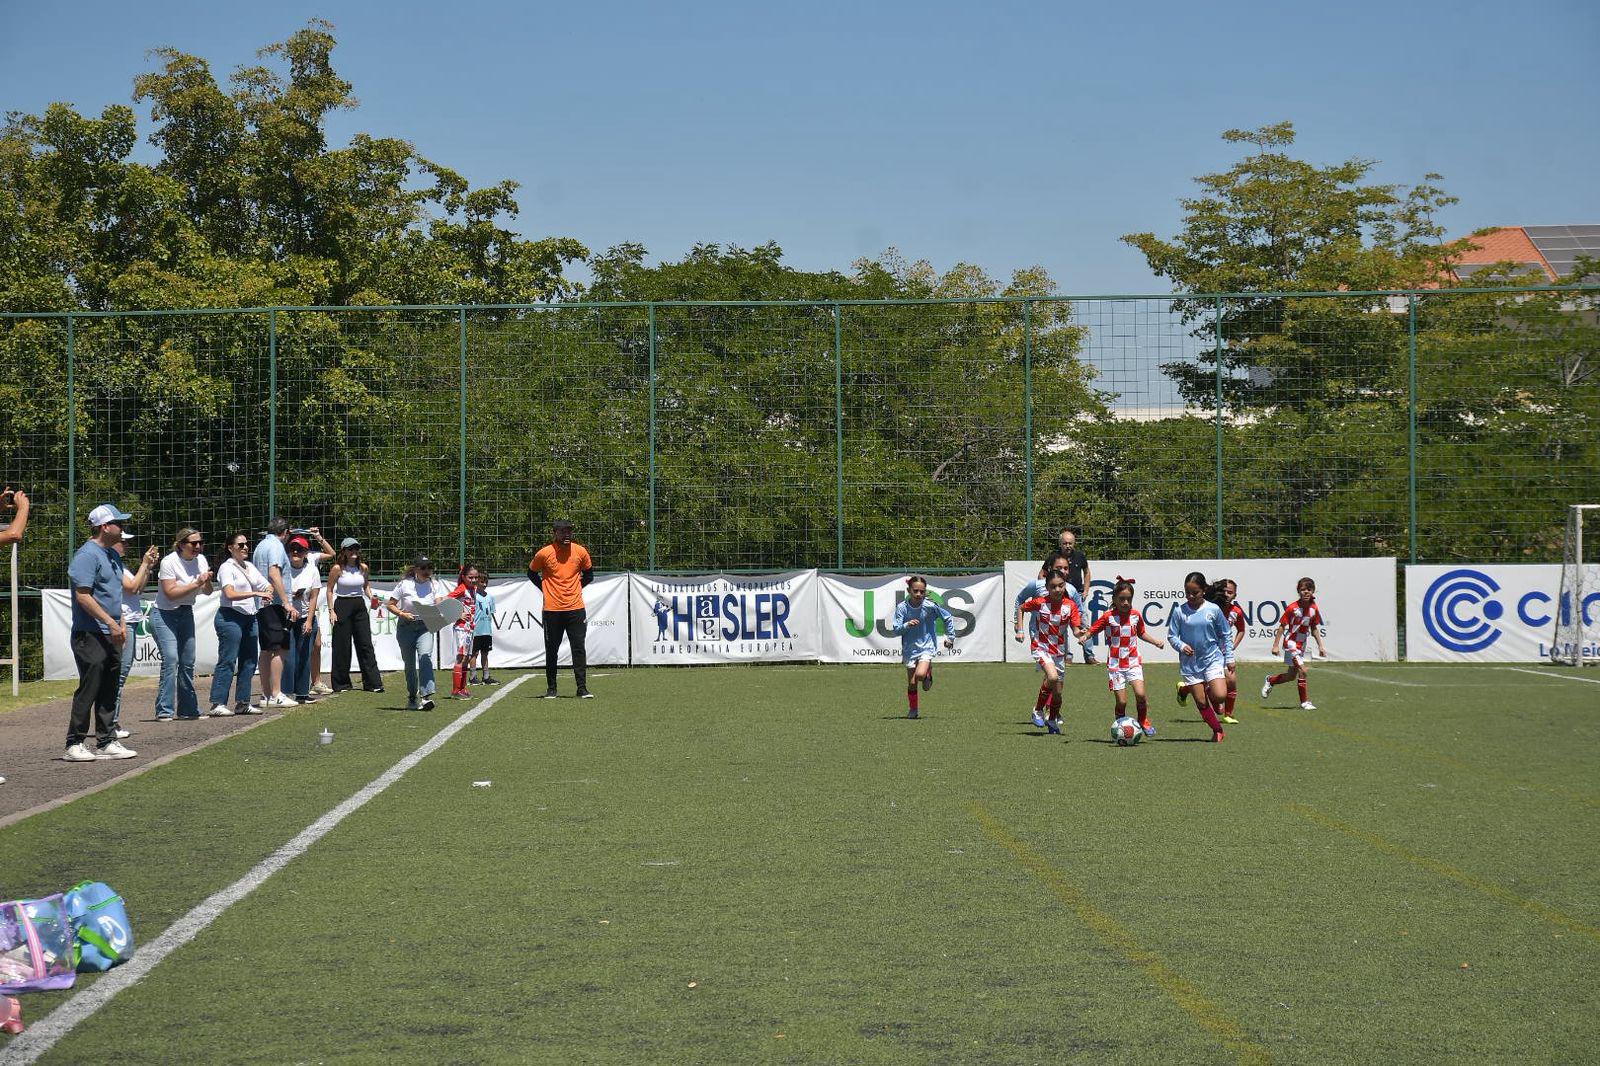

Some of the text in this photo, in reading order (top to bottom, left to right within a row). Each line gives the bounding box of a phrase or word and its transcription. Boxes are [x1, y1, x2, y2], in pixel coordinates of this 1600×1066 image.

[651, 583, 717, 593] LABORATORIOS
[1143, 590, 1188, 599] SEGURO
[1249, 628, 1257, 638] &
[652, 642, 794, 654] HOMEOPATIA EUROPEA
[853, 648, 890, 657] NOTARIO
[948, 648, 962, 657] 199
